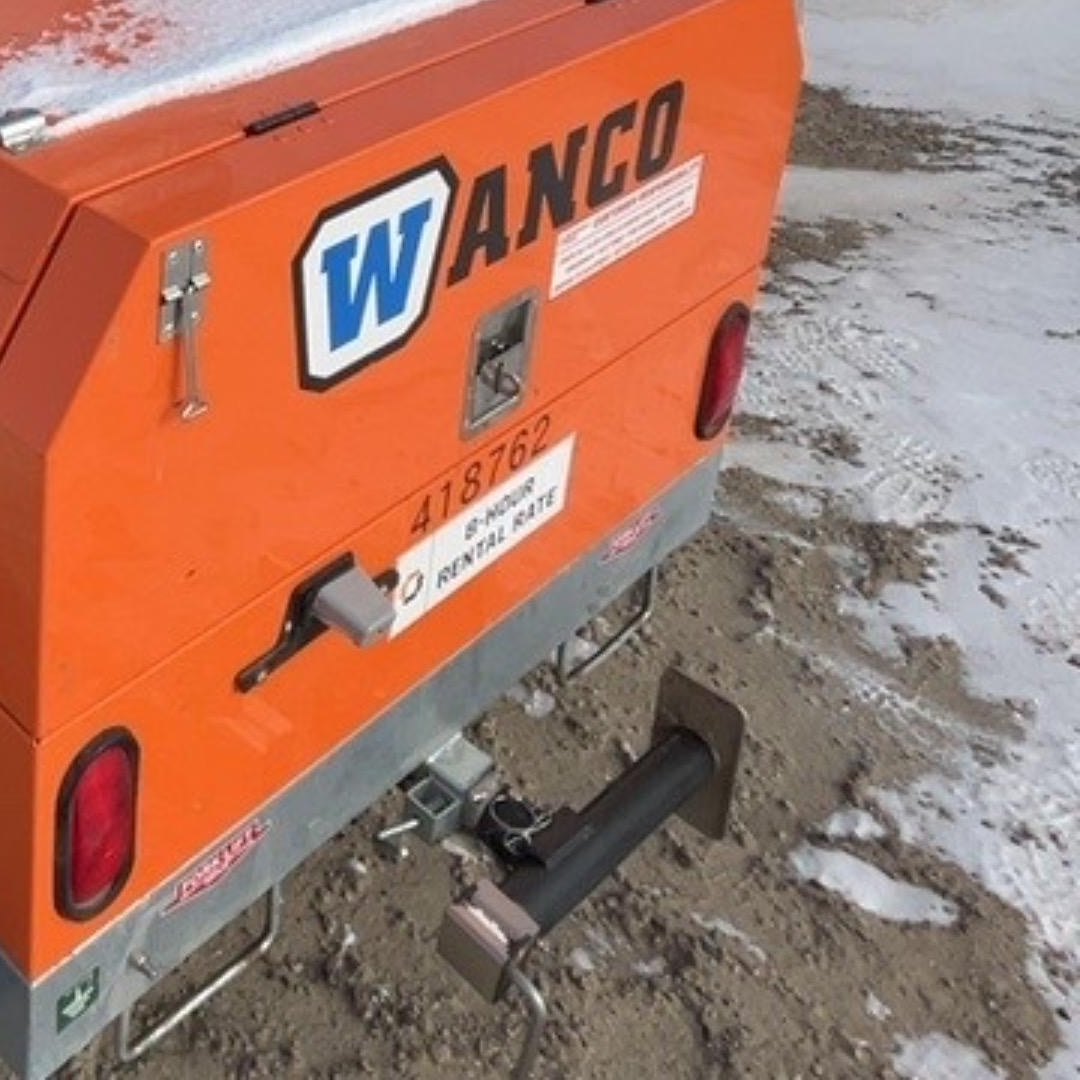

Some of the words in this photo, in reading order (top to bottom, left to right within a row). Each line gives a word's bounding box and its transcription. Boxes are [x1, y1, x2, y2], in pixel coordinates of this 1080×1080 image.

[320, 80, 684, 352] WANCO
[411, 414, 550, 535] 418762
[437, 526, 505, 588] RENTAL
[512, 485, 558, 532] RATE
